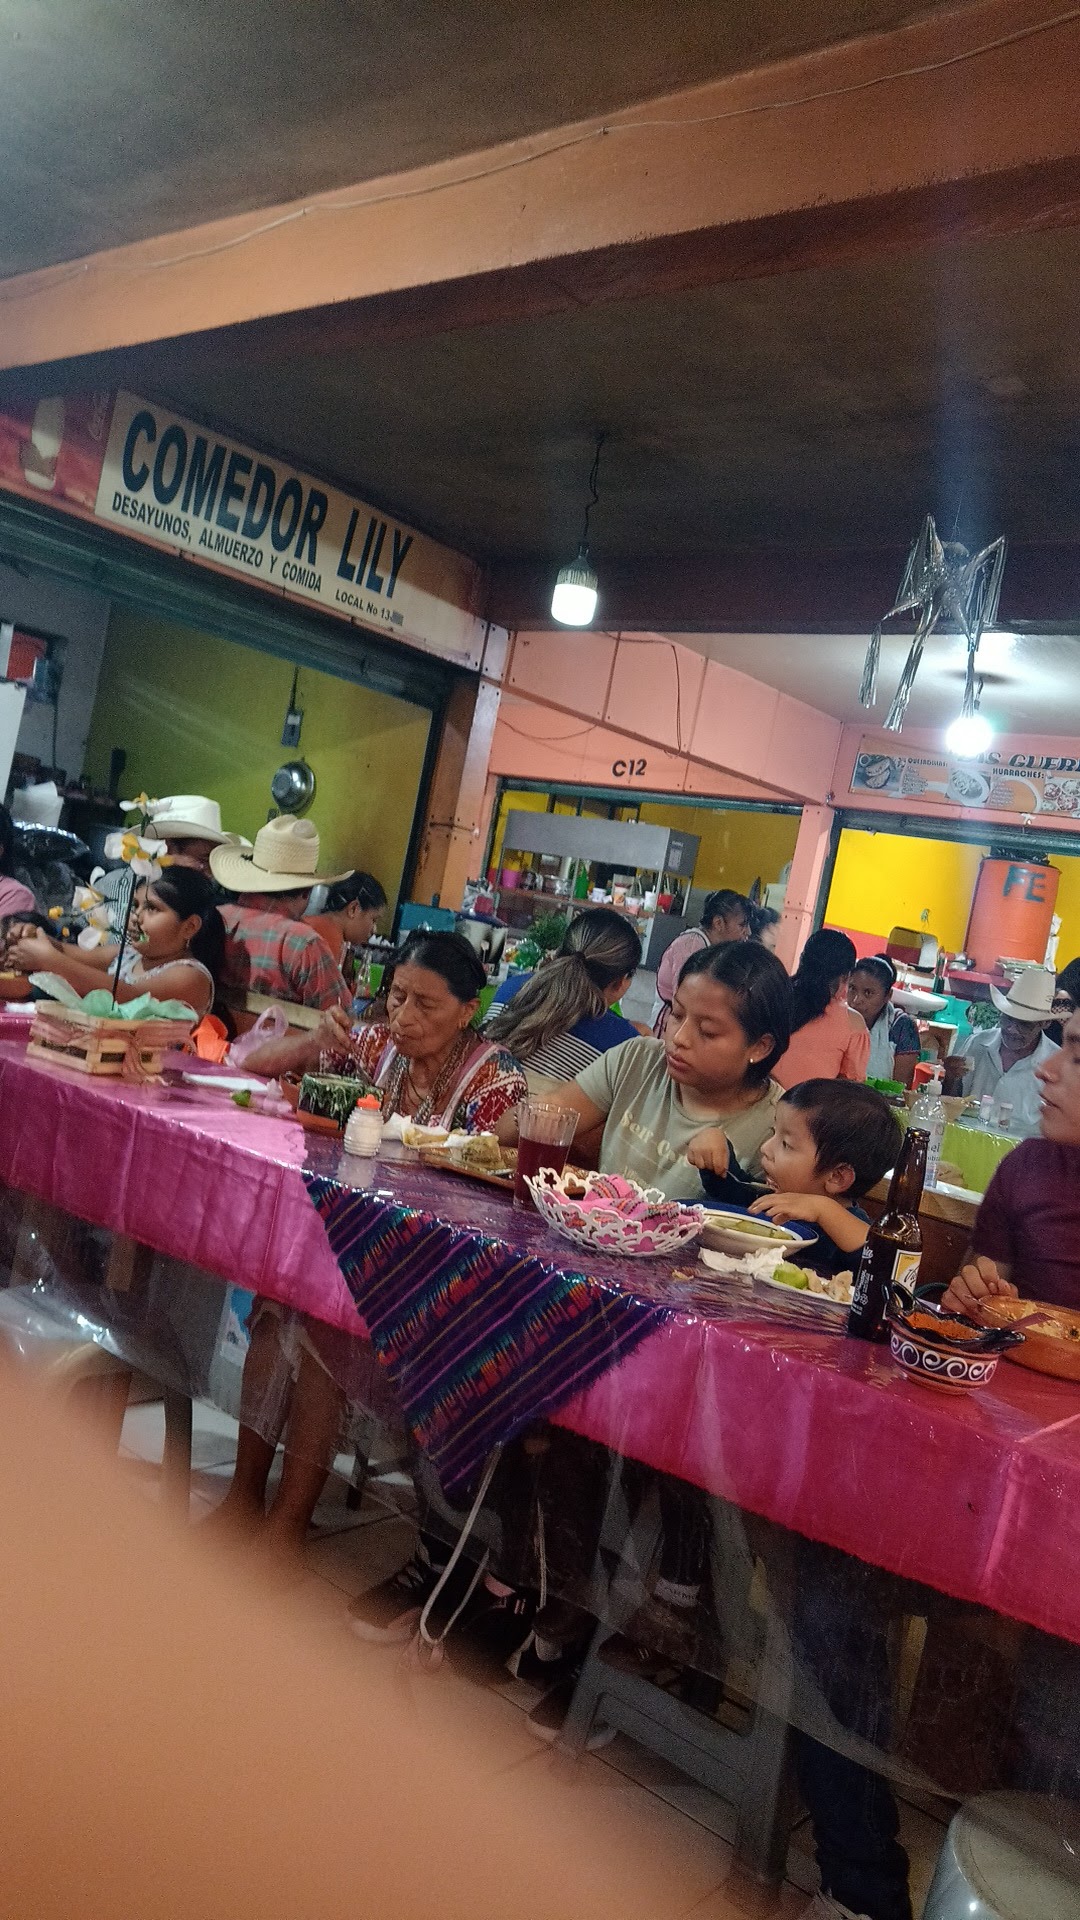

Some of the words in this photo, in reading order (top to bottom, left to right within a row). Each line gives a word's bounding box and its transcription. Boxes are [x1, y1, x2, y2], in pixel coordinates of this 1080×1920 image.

[122, 411, 328, 567] COMEDOR
[336, 507, 413, 599] LILY
[112, 491, 191, 543] DESAYUNOS,
[199, 527, 264, 568] ALMUERZO
[269, 555, 278, 574] Y
[282, 561, 322, 592] COMIDA
[335, 589, 363, 611] LOCAL
[612, 759, 648, 777] C12
[992, 768, 1044, 779] HUARACHES:
[1008, 753, 1080, 772] GUER
[1002, 864, 1046, 903] FE
